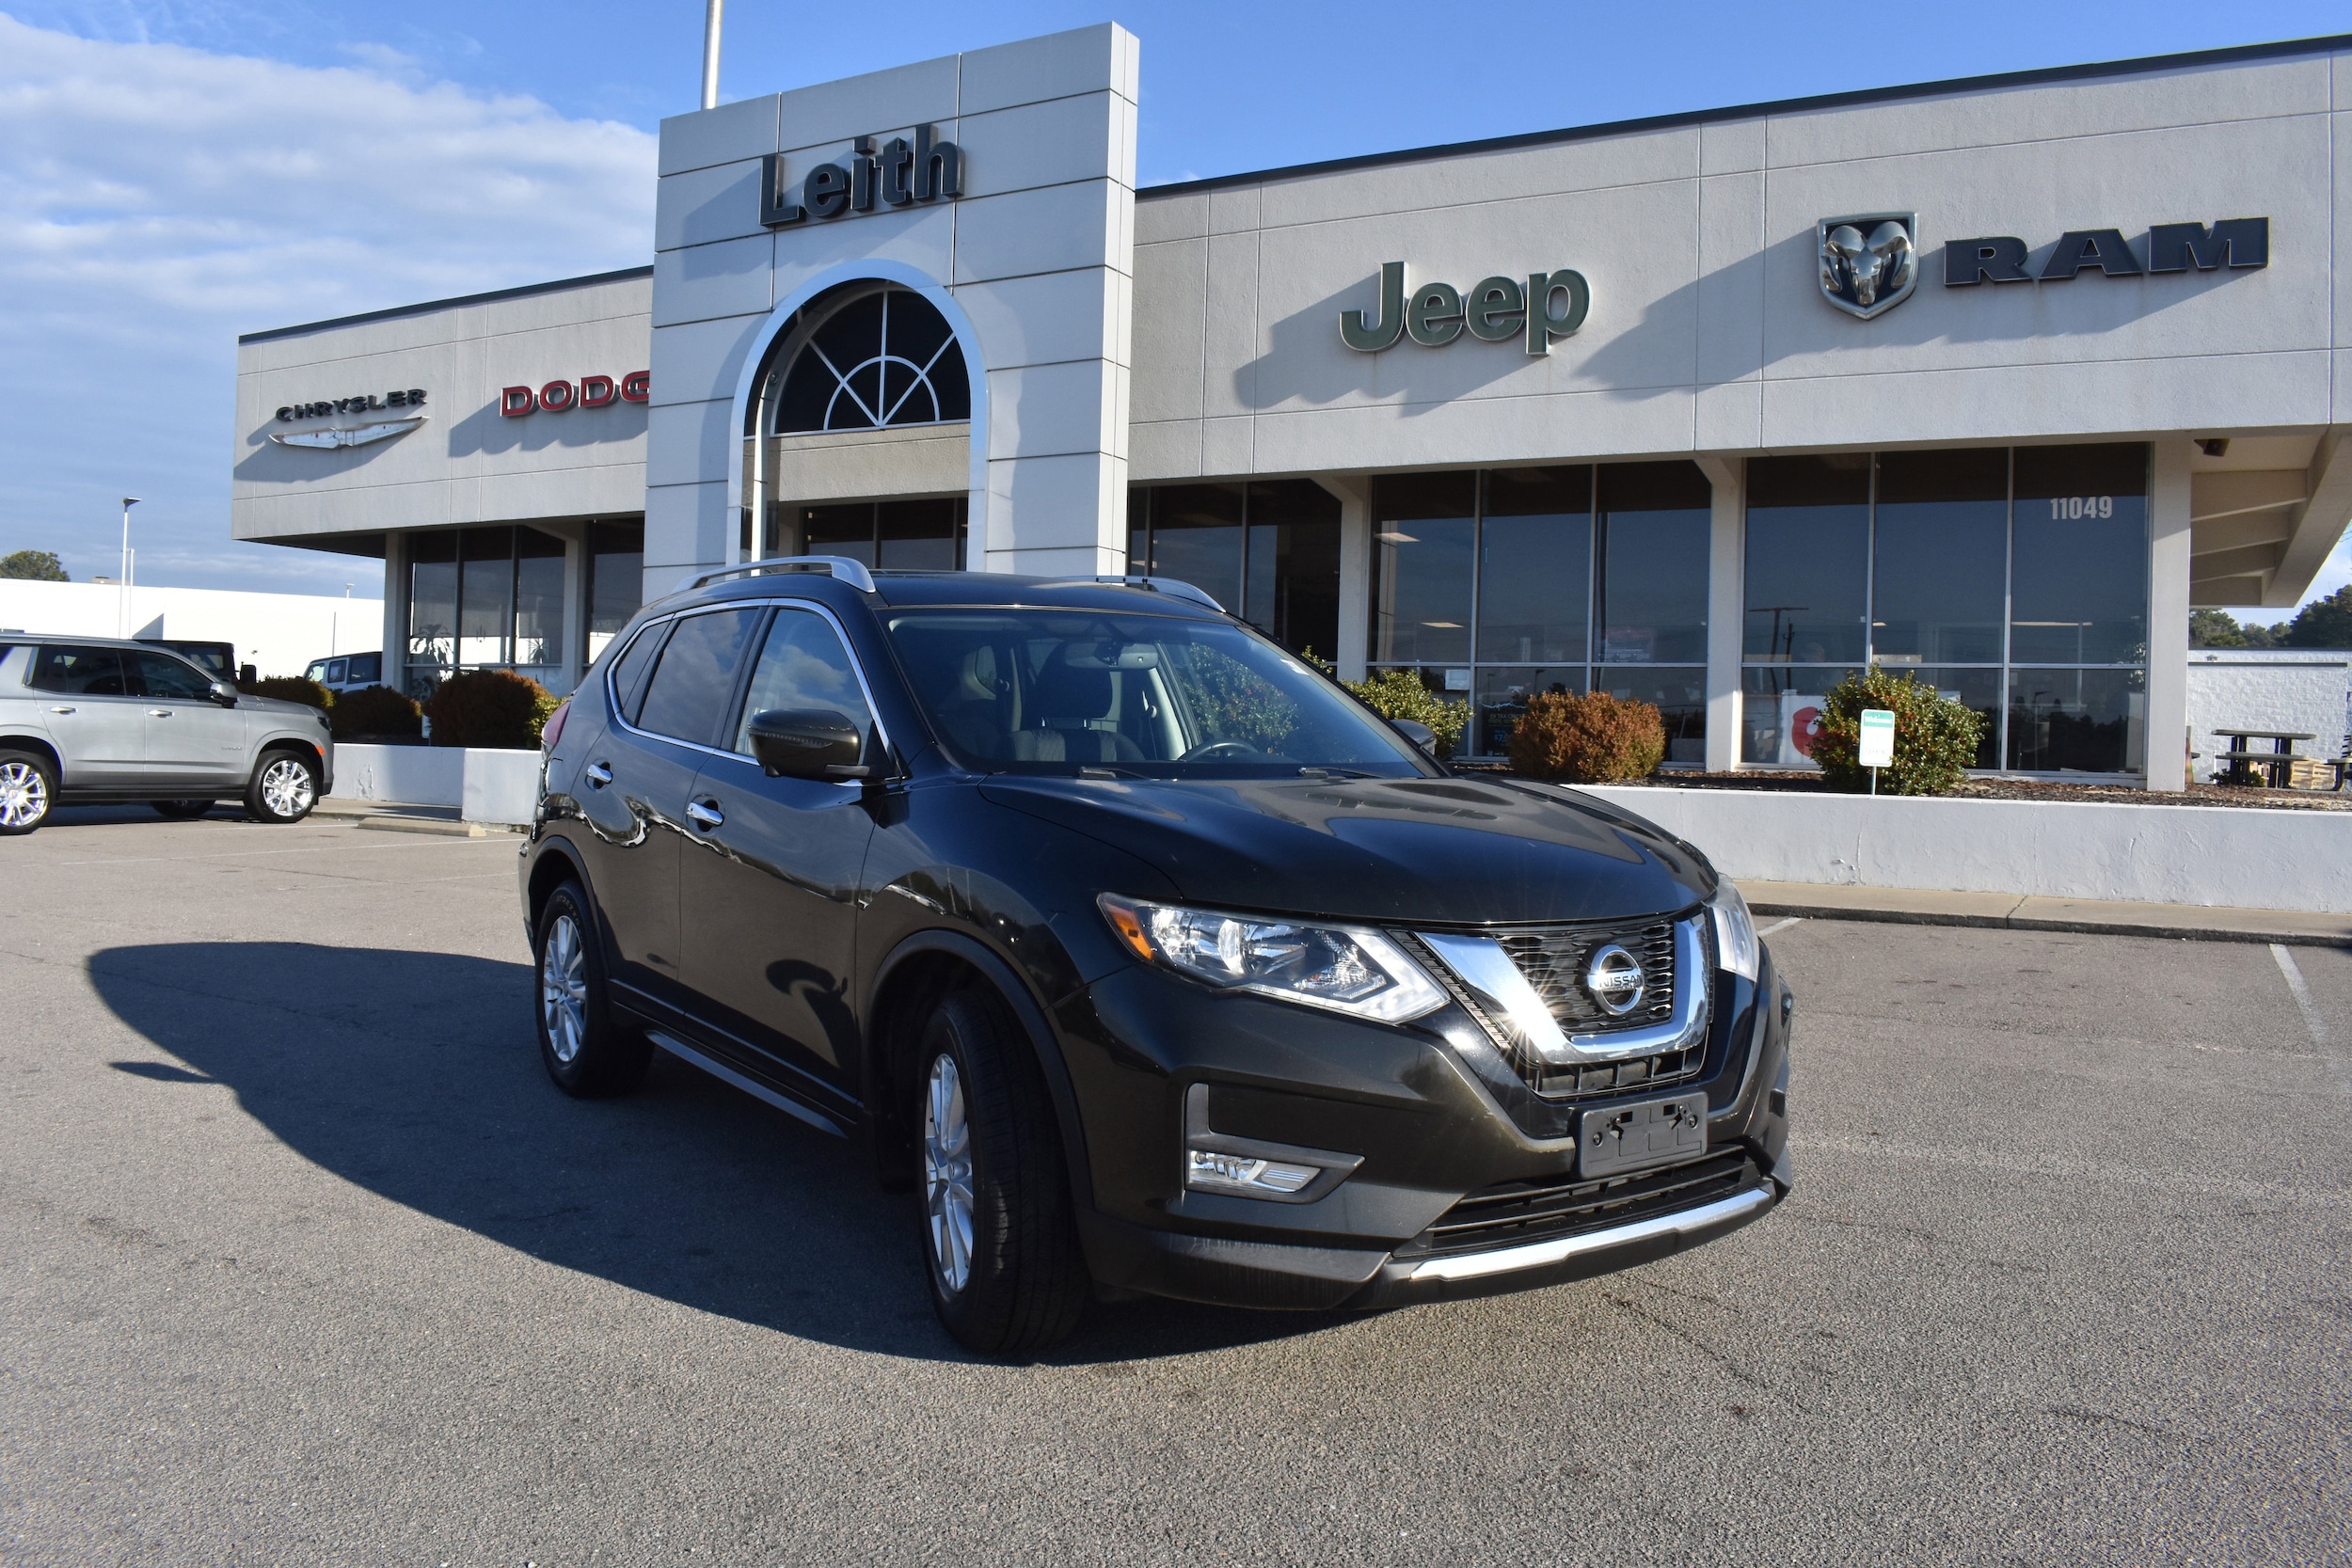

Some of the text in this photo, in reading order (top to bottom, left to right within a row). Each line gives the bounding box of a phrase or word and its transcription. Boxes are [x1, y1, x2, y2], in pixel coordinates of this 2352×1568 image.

[759, 124, 965, 228] Leith
[1944, 216, 2269, 288] RAM
[1340, 261, 1592, 356] Jeep
[276, 388, 427, 421] CHRYSLER
[500, 371, 649, 417] DODG
[2050, 495, 2113, 520] 11049
[1599, 974, 1642, 989] NISSAN
